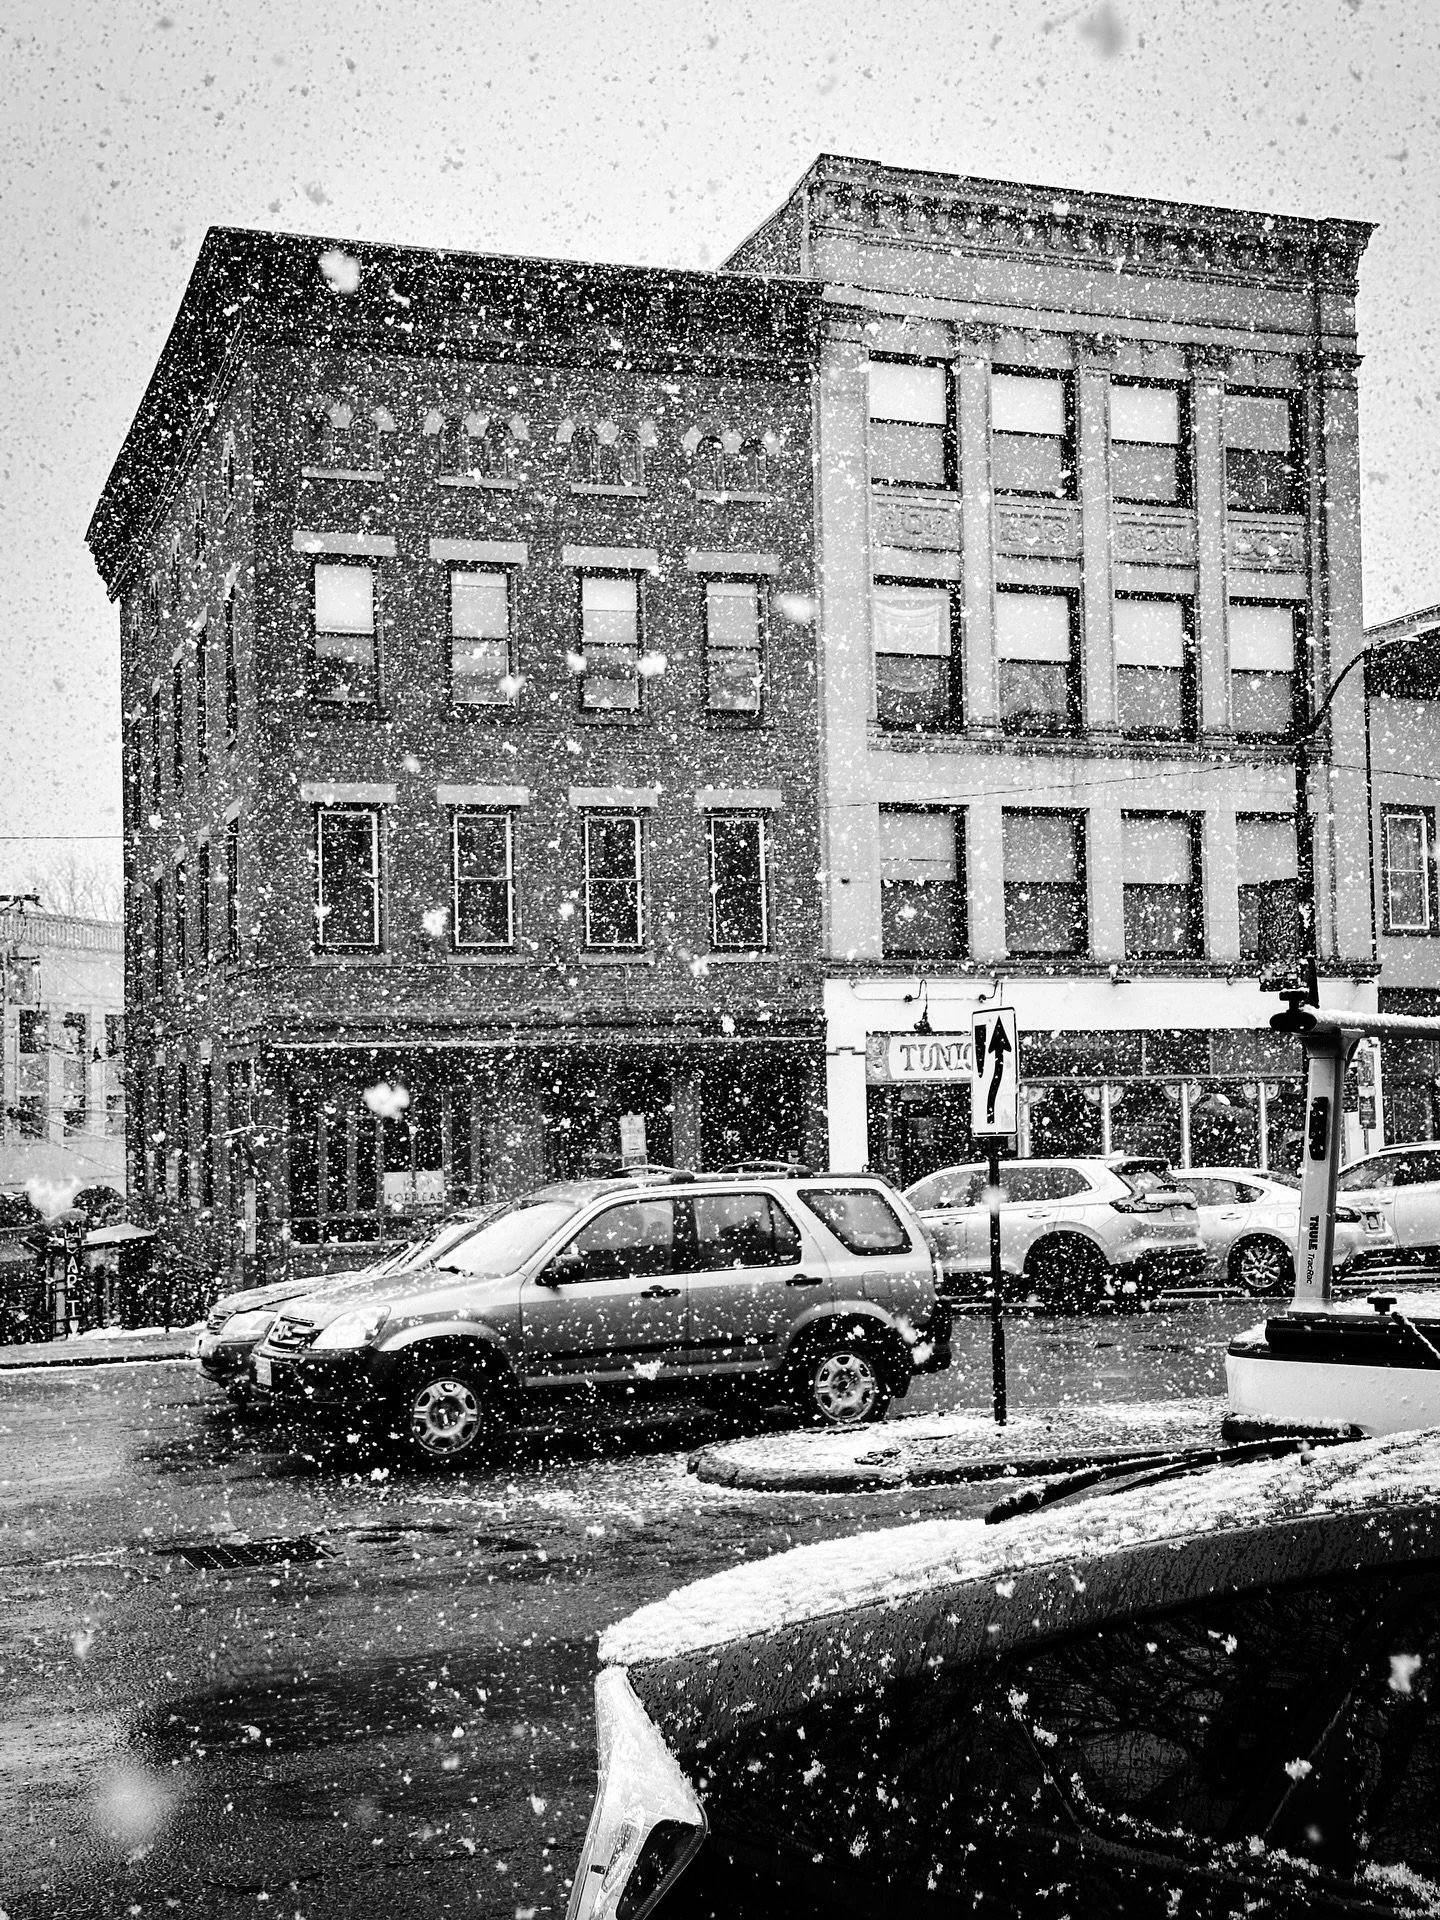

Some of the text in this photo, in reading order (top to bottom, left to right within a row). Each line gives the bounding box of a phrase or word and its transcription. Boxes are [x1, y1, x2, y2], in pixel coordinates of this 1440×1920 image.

[415, 1191, 445, 1202] LEAS
[1306, 1216, 1319, 1285] THULE TracRac
